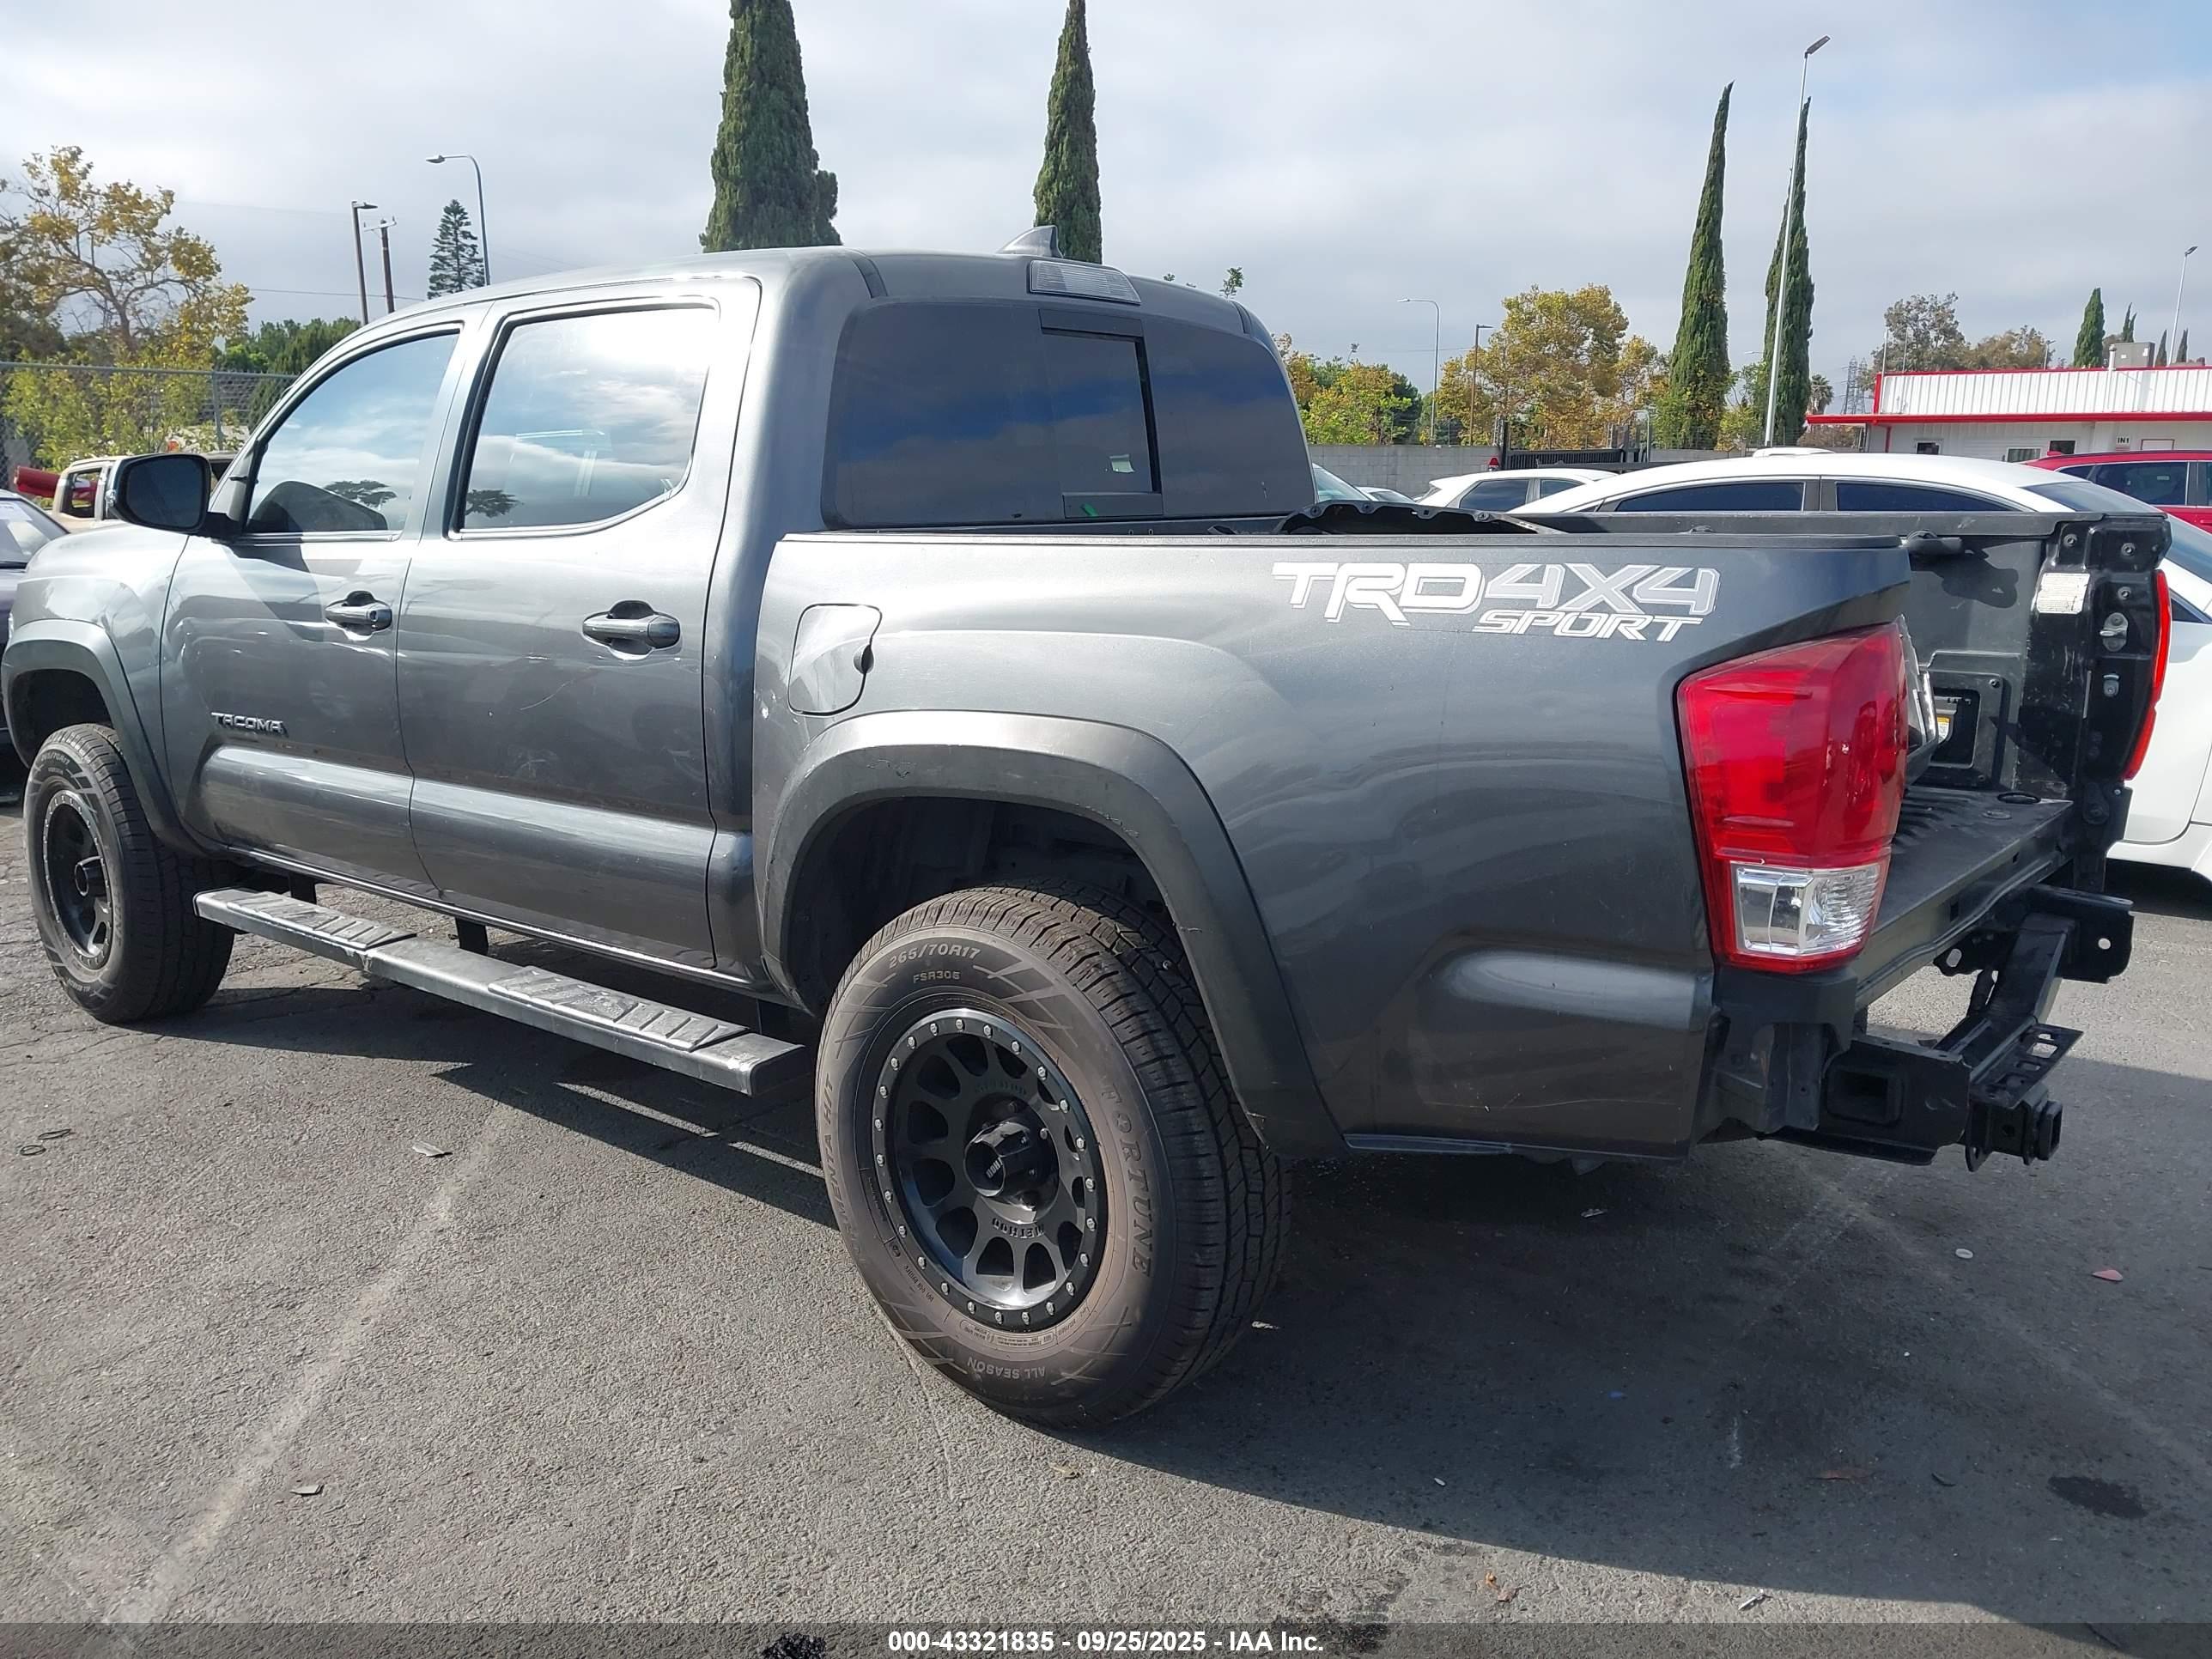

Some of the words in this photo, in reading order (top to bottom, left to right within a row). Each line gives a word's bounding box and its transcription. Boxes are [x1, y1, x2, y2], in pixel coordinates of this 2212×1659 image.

[1271, 562, 1485, 626] TRD
[1472, 610, 1704, 642] SPORT
[210, 711, 284, 734] TACOMA
[888, 943, 981, 969] 265/70R17
[1100, 1082, 1153, 1278] FORTUNE
[992, 1218, 1046, 1240] METHOD
[966, 1356, 1020, 1380] SEASON
[1023, 1365, 1046, 1379] ALL
